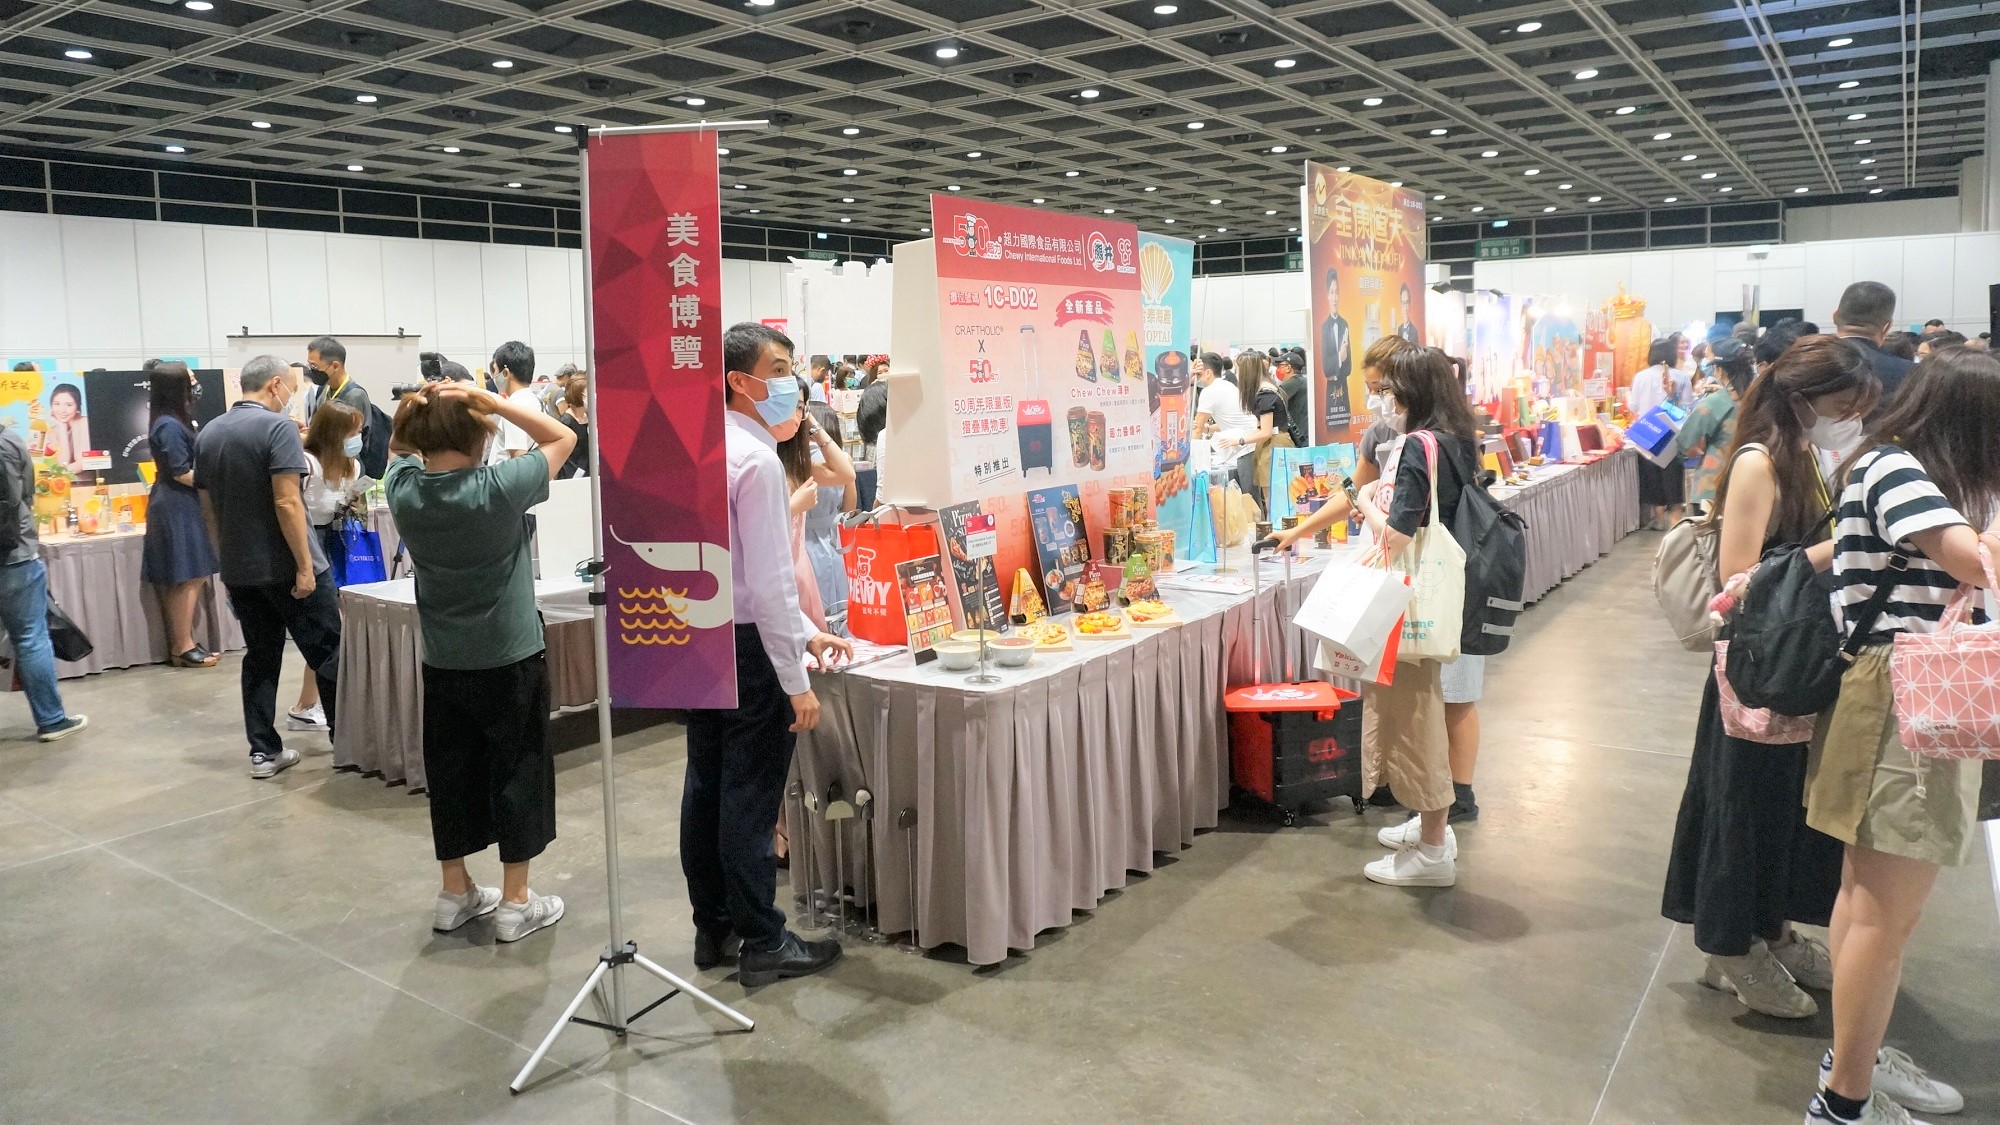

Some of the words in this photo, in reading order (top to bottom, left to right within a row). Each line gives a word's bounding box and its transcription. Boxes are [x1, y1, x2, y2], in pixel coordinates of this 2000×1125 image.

[1003, 231, 1082, 254] 超力國際食品有限公司
[1004, 249, 1024, 262] Chewy
[1025, 251, 1056, 264] International
[1057, 254, 1072, 265] Foods
[667, 212, 704, 370] 美食博覽
[984, 284, 1039, 310] 1C-D02
[1065, 299, 1103, 314] 全新產品
[978, 339, 985, 353] X
[1071, 387, 1093, 398] Chew
[954, 395, 1012, 412] 50周年限量版
[962, 417, 1008, 435] 摺疊購物車
[974, 456, 1010, 477] 特別推出
[1403, 620, 1434, 629] osme
[1401, 630, 1427, 640] tore
